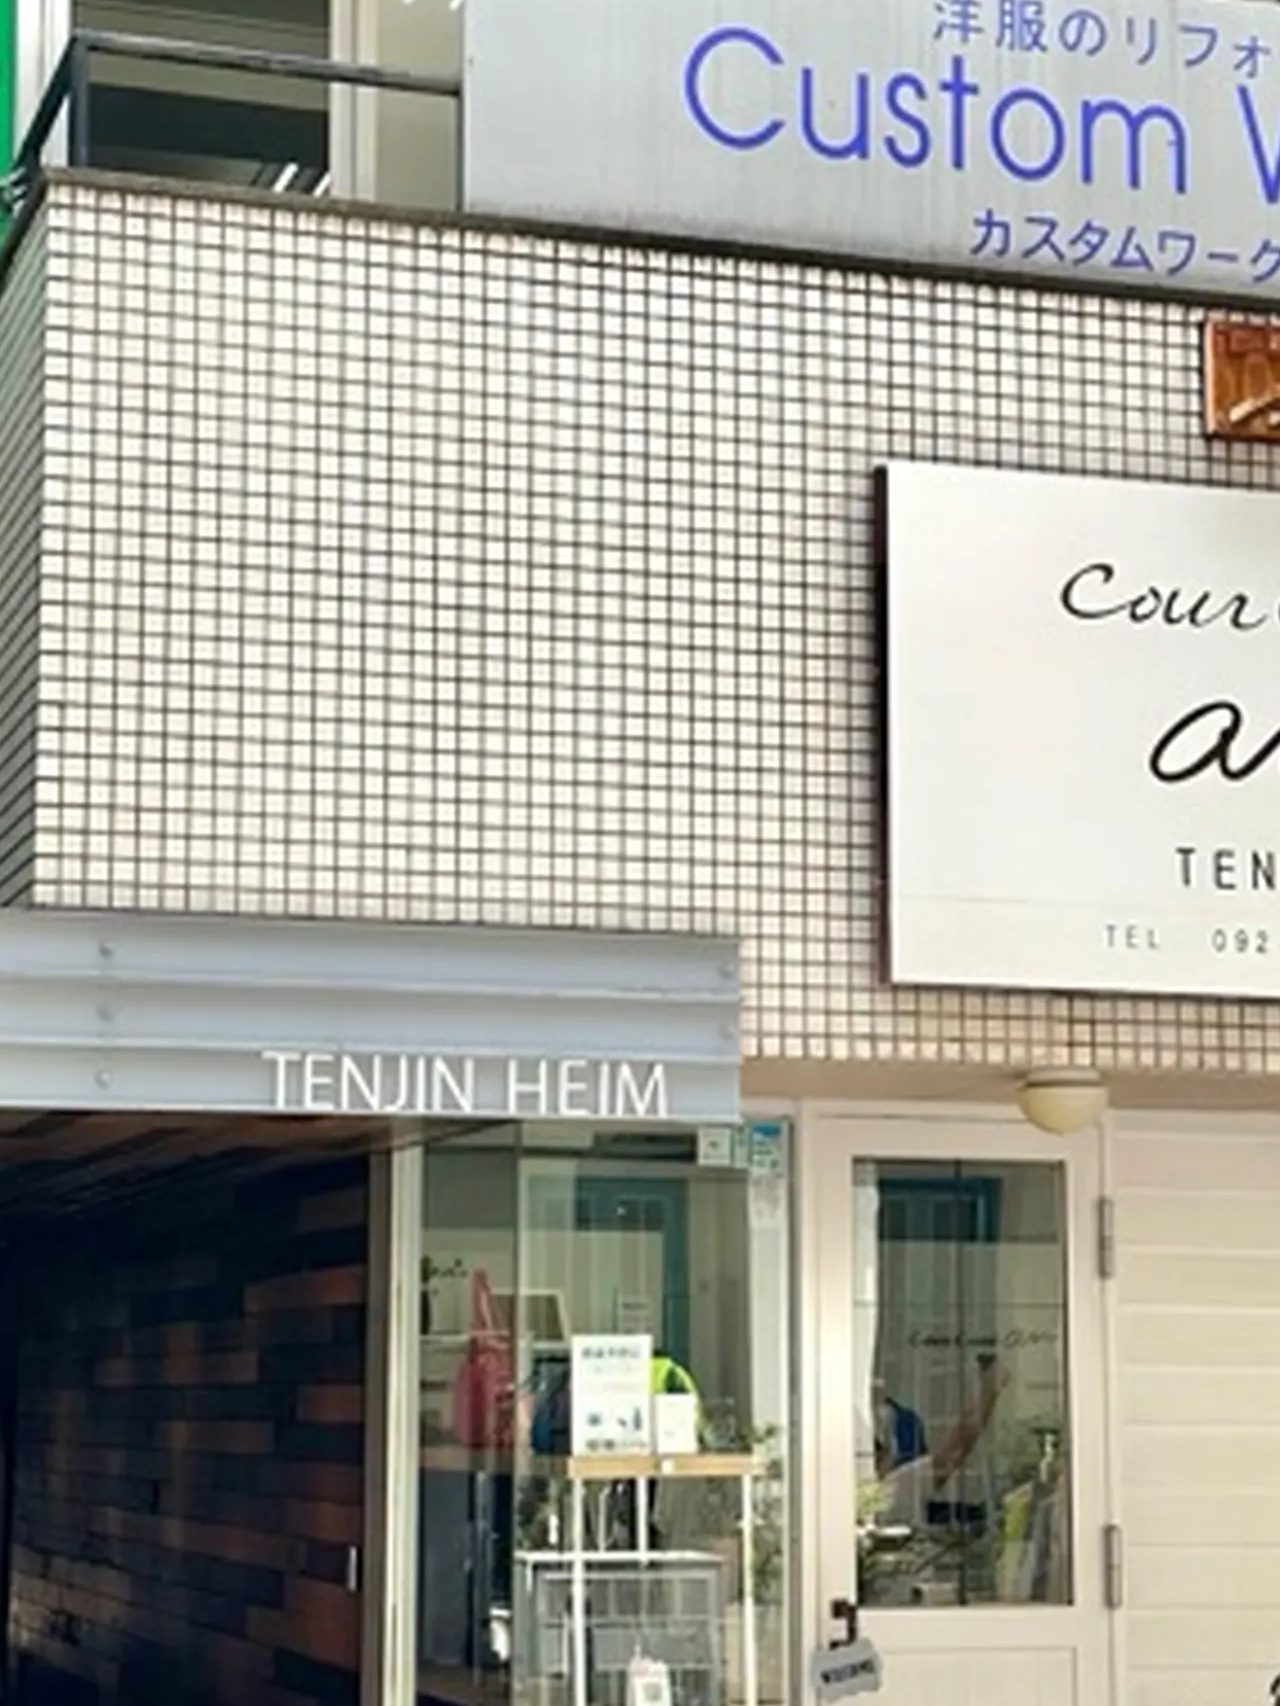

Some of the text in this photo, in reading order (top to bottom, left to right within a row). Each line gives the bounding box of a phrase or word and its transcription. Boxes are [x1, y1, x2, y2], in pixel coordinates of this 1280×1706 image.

[684, 26, 1188, 194] Custom
[1059, 561, 1267, 631] Cour
[1105, 924, 1160, 951] TEL
[261, 1050, 668, 1118] TENJIN HEIM
